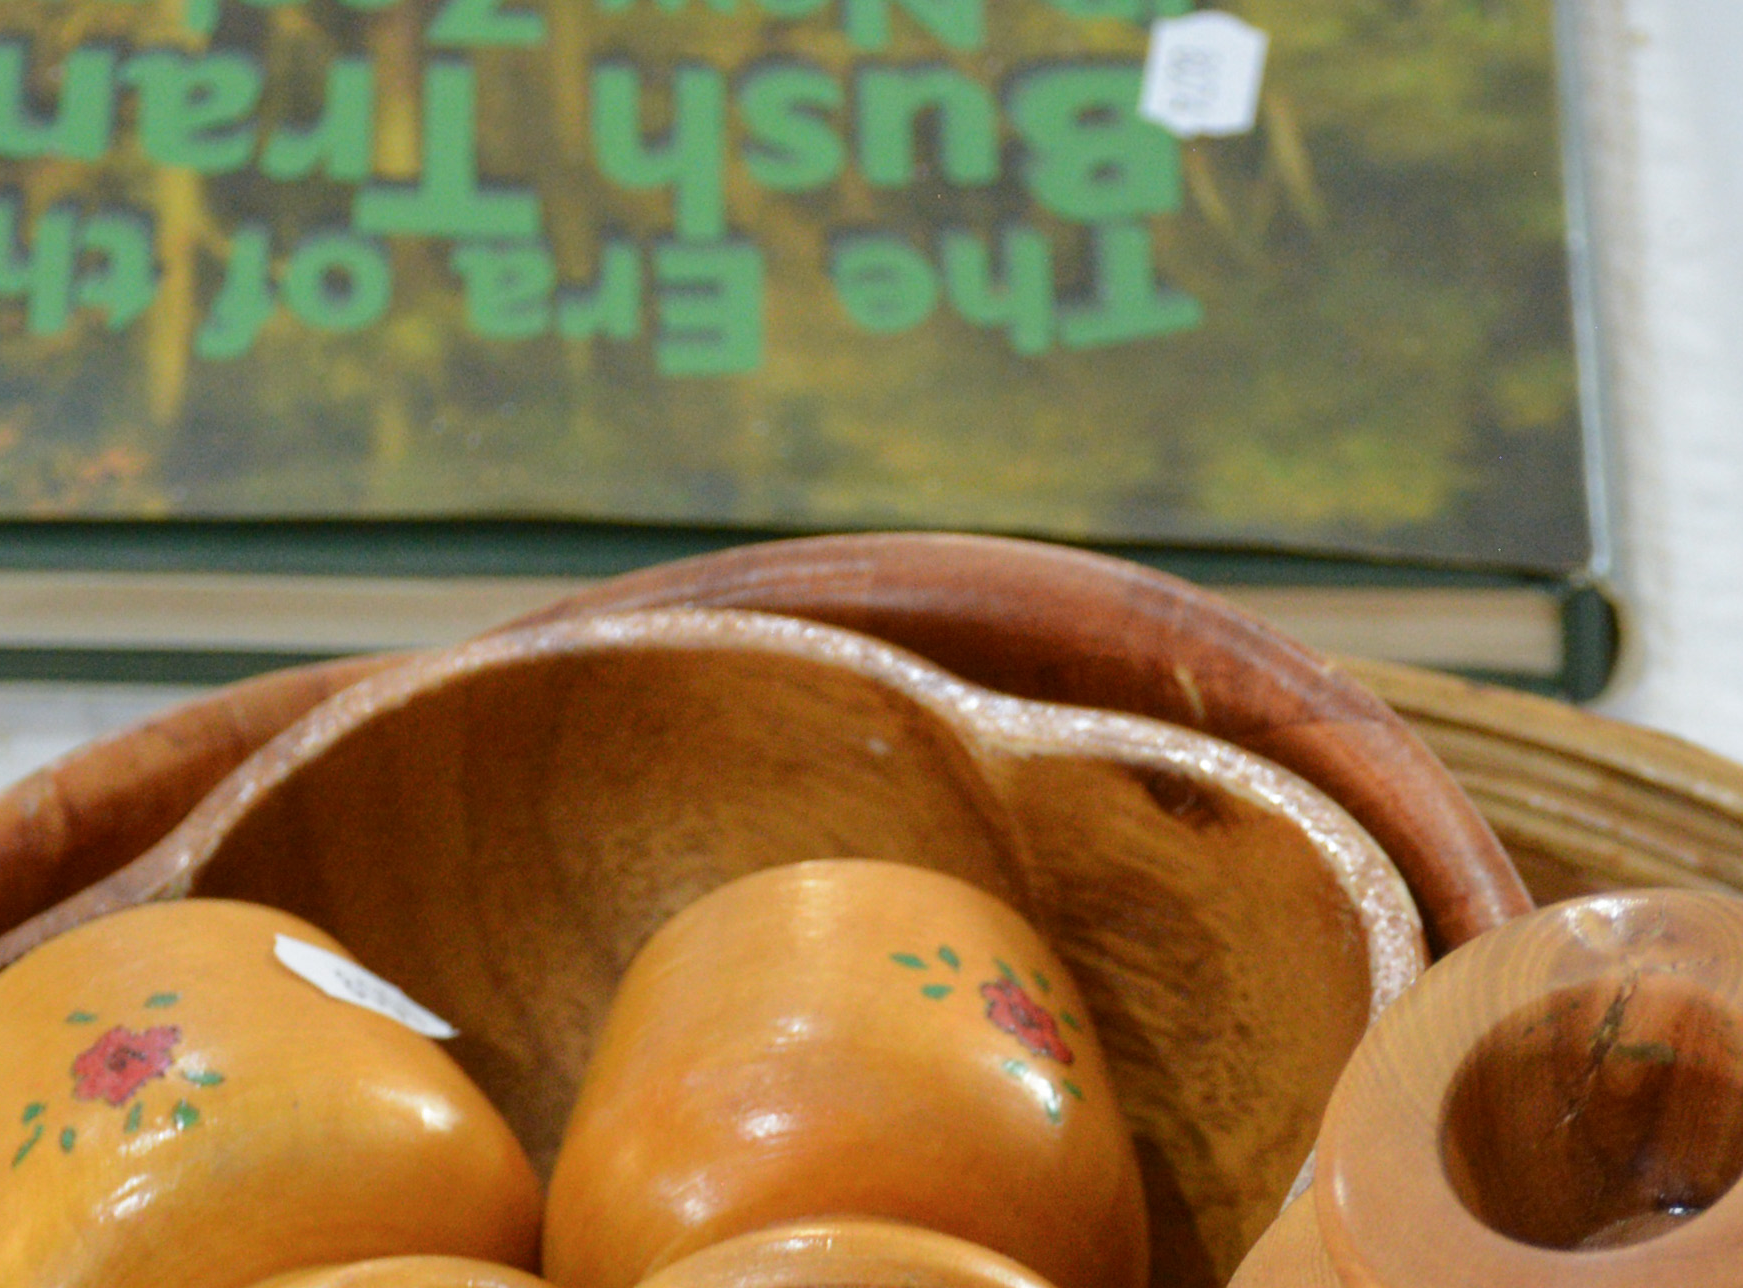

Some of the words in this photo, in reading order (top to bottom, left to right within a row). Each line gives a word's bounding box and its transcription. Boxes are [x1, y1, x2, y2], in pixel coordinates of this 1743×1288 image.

[587, 60, 1185, 242] Bush
[194, 225, 393, 360] of
[450, 238, 764, 375] Era
[829, 222, 1204, 356] The
